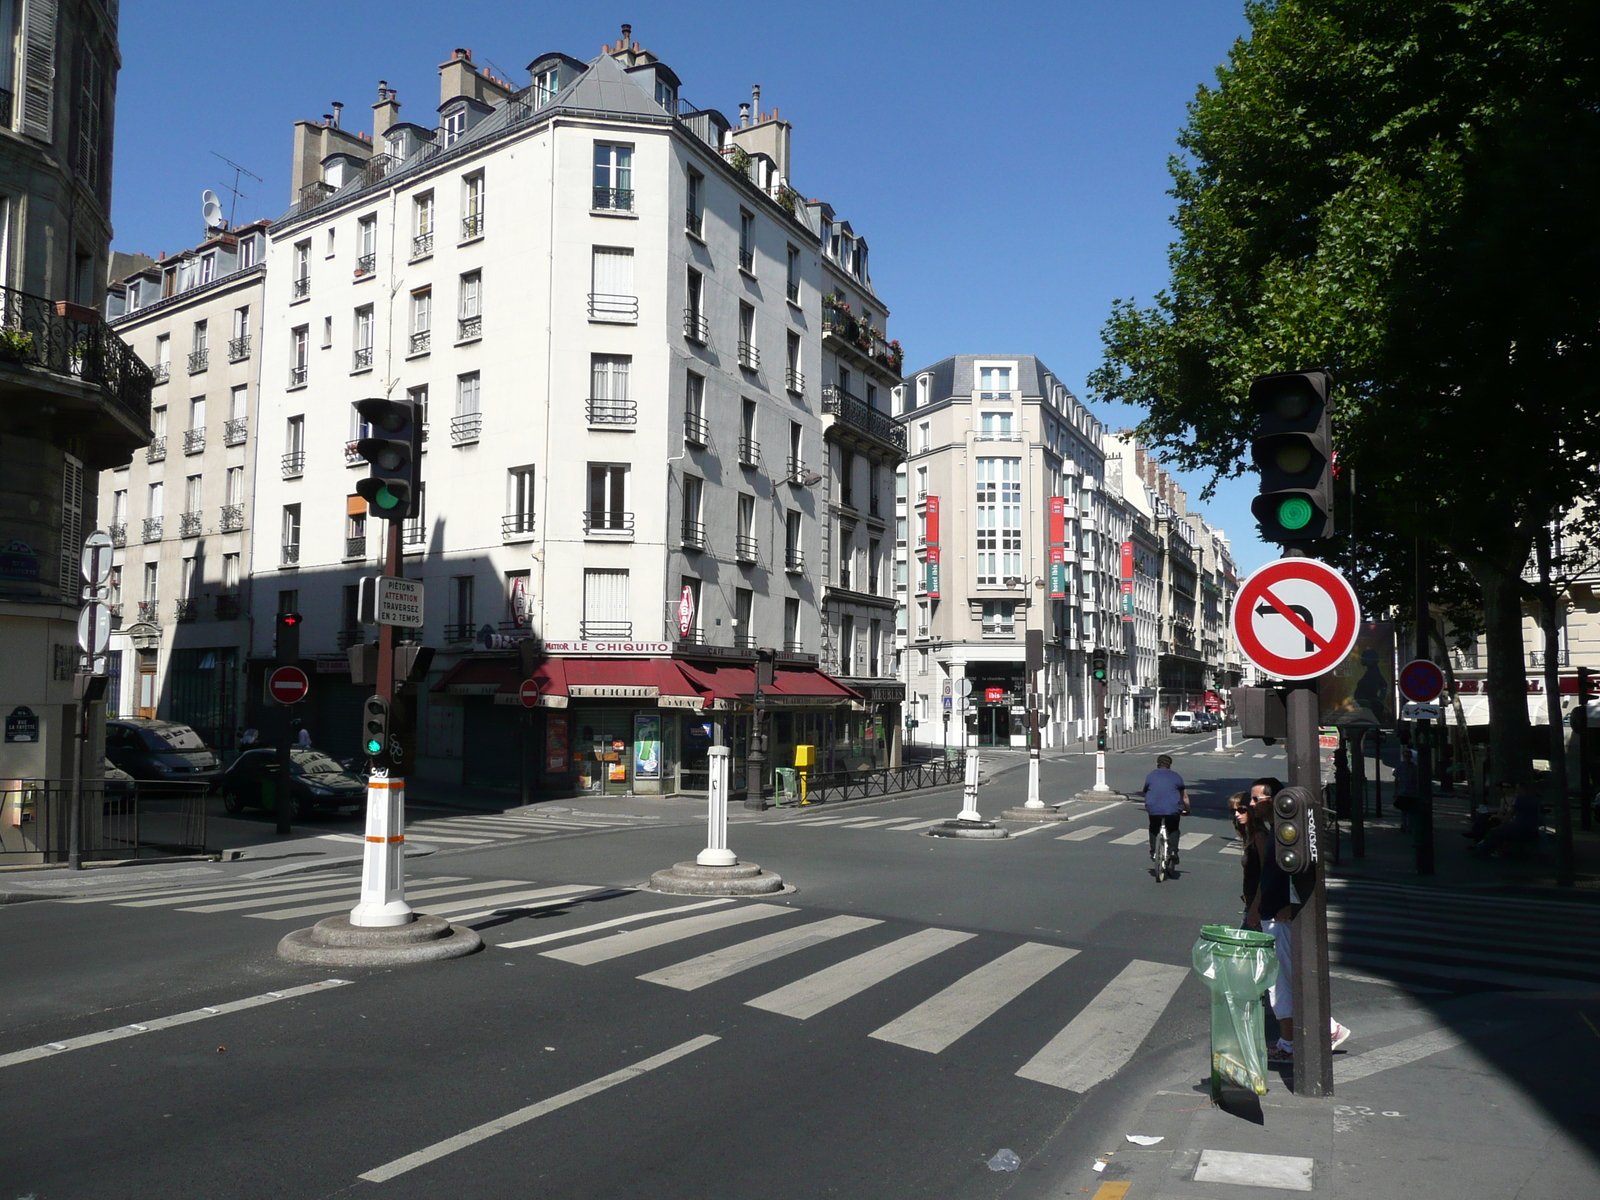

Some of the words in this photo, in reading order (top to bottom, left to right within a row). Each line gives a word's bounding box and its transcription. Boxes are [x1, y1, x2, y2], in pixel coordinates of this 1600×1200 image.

[388, 581, 414, 592] PIÉTONS
[385, 592, 418, 602] ATTENTION
[383, 602, 419, 613] TRAVERSEZ
[517, 582, 525, 625] TABAC
[681, 590, 689, 632] TABAC
[381, 612, 390, 620] EN
[392, 613, 397, 621] 2
[399, 614, 420, 623] TEMPS
[595, 643, 668, 651] CHIQUITO
[594, 688, 650, 696] CHIQUITO
[871, 687, 903, 700] MEUBLES
